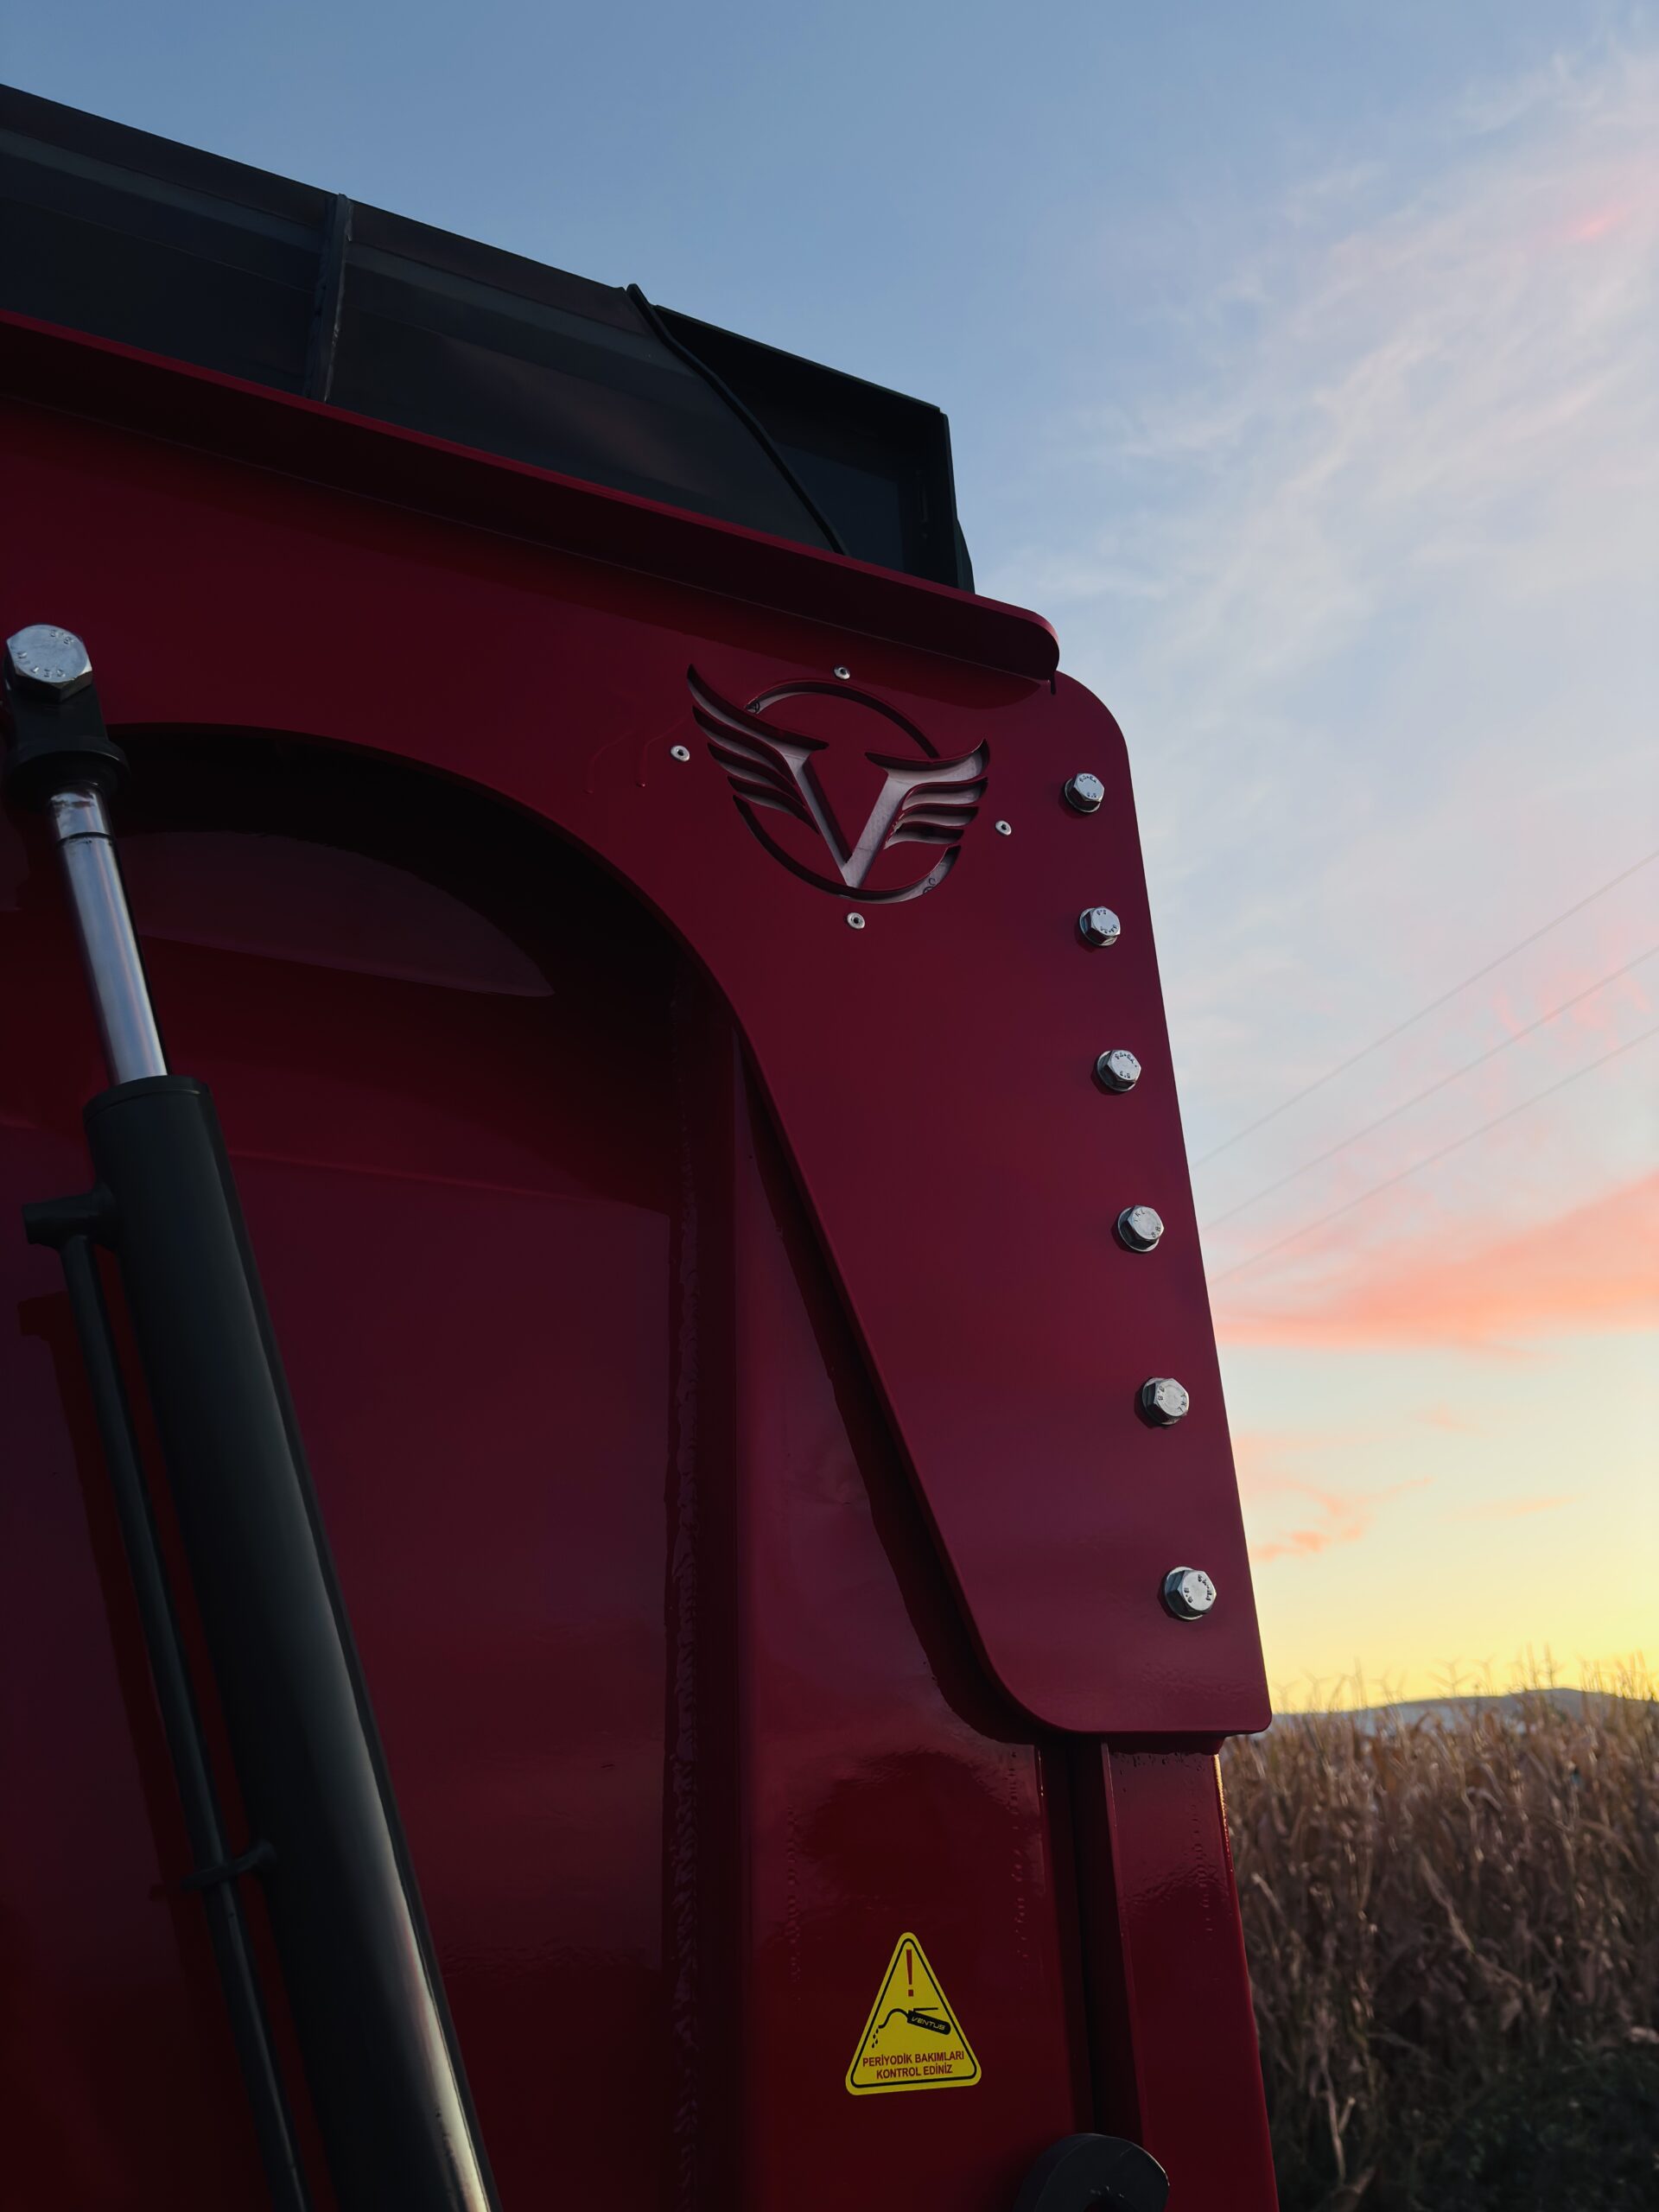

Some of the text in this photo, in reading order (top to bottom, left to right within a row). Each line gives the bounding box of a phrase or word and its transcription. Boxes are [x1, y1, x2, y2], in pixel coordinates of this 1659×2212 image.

[911, 2015, 947, 2031] VENTUS
[862, 2050, 964, 2068] PERİYODİK BAKIMLARI
[876, 2062, 953, 2080] KONTROL EDİNİZ
